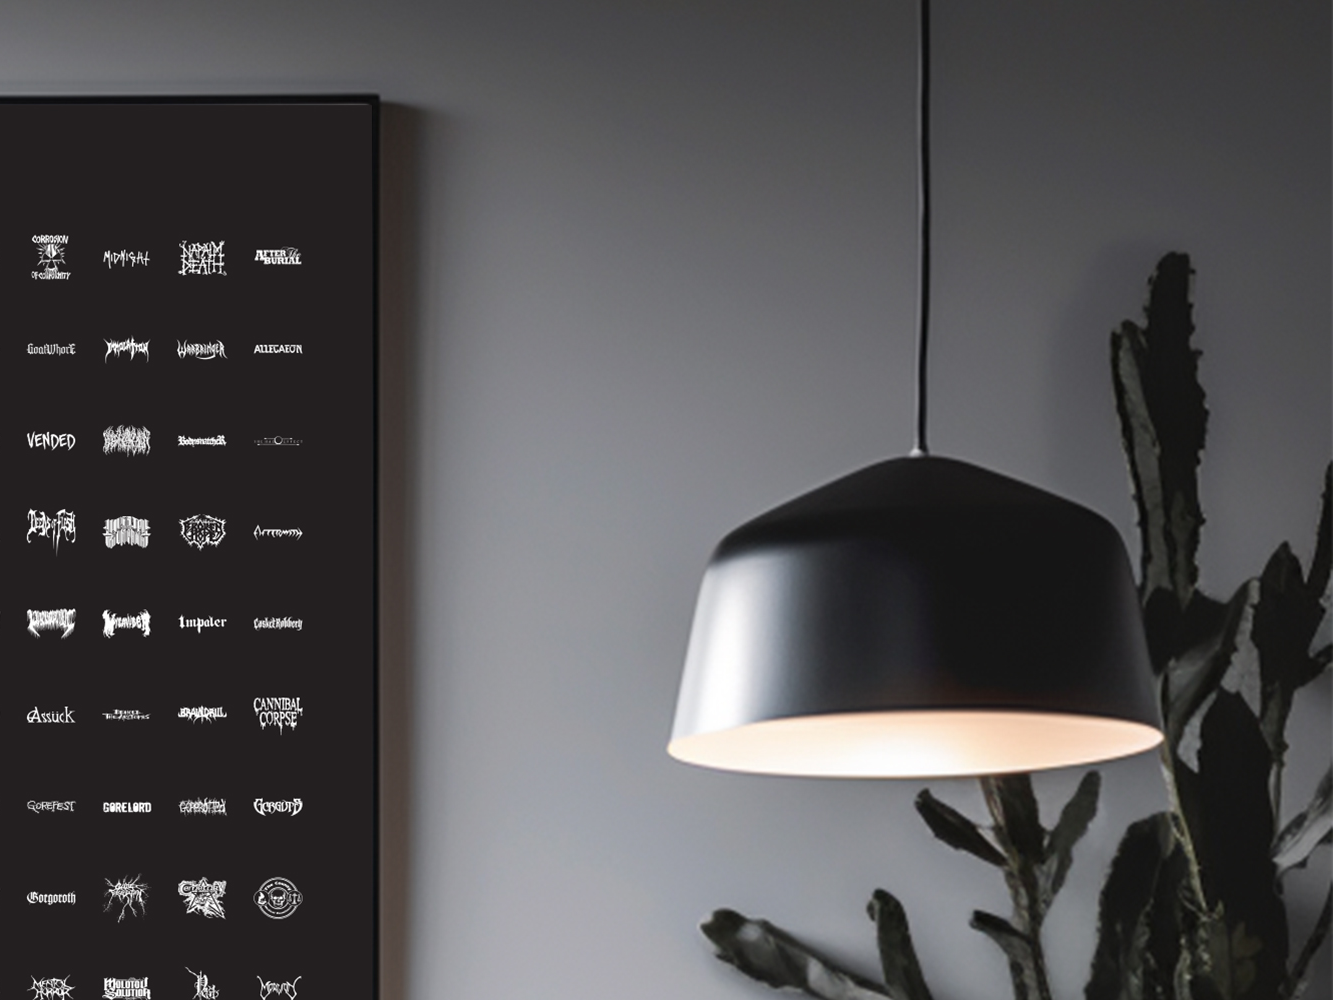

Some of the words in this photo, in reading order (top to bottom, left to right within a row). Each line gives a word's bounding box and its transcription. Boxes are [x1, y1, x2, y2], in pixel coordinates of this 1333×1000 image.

[32, 234, 69, 244] CORROSION
[255, 250, 286, 260] AFTER
[264, 257, 302, 265] BURIAL
[178, 254, 227, 276] DEATH
[27, 431, 76, 450] VENDED
[179, 615, 227, 633] Impaler
[253, 697, 303, 716] CANNIBAL
[259, 711, 297, 735] CORPSE
[27, 891, 76, 905] Gorgoroth
